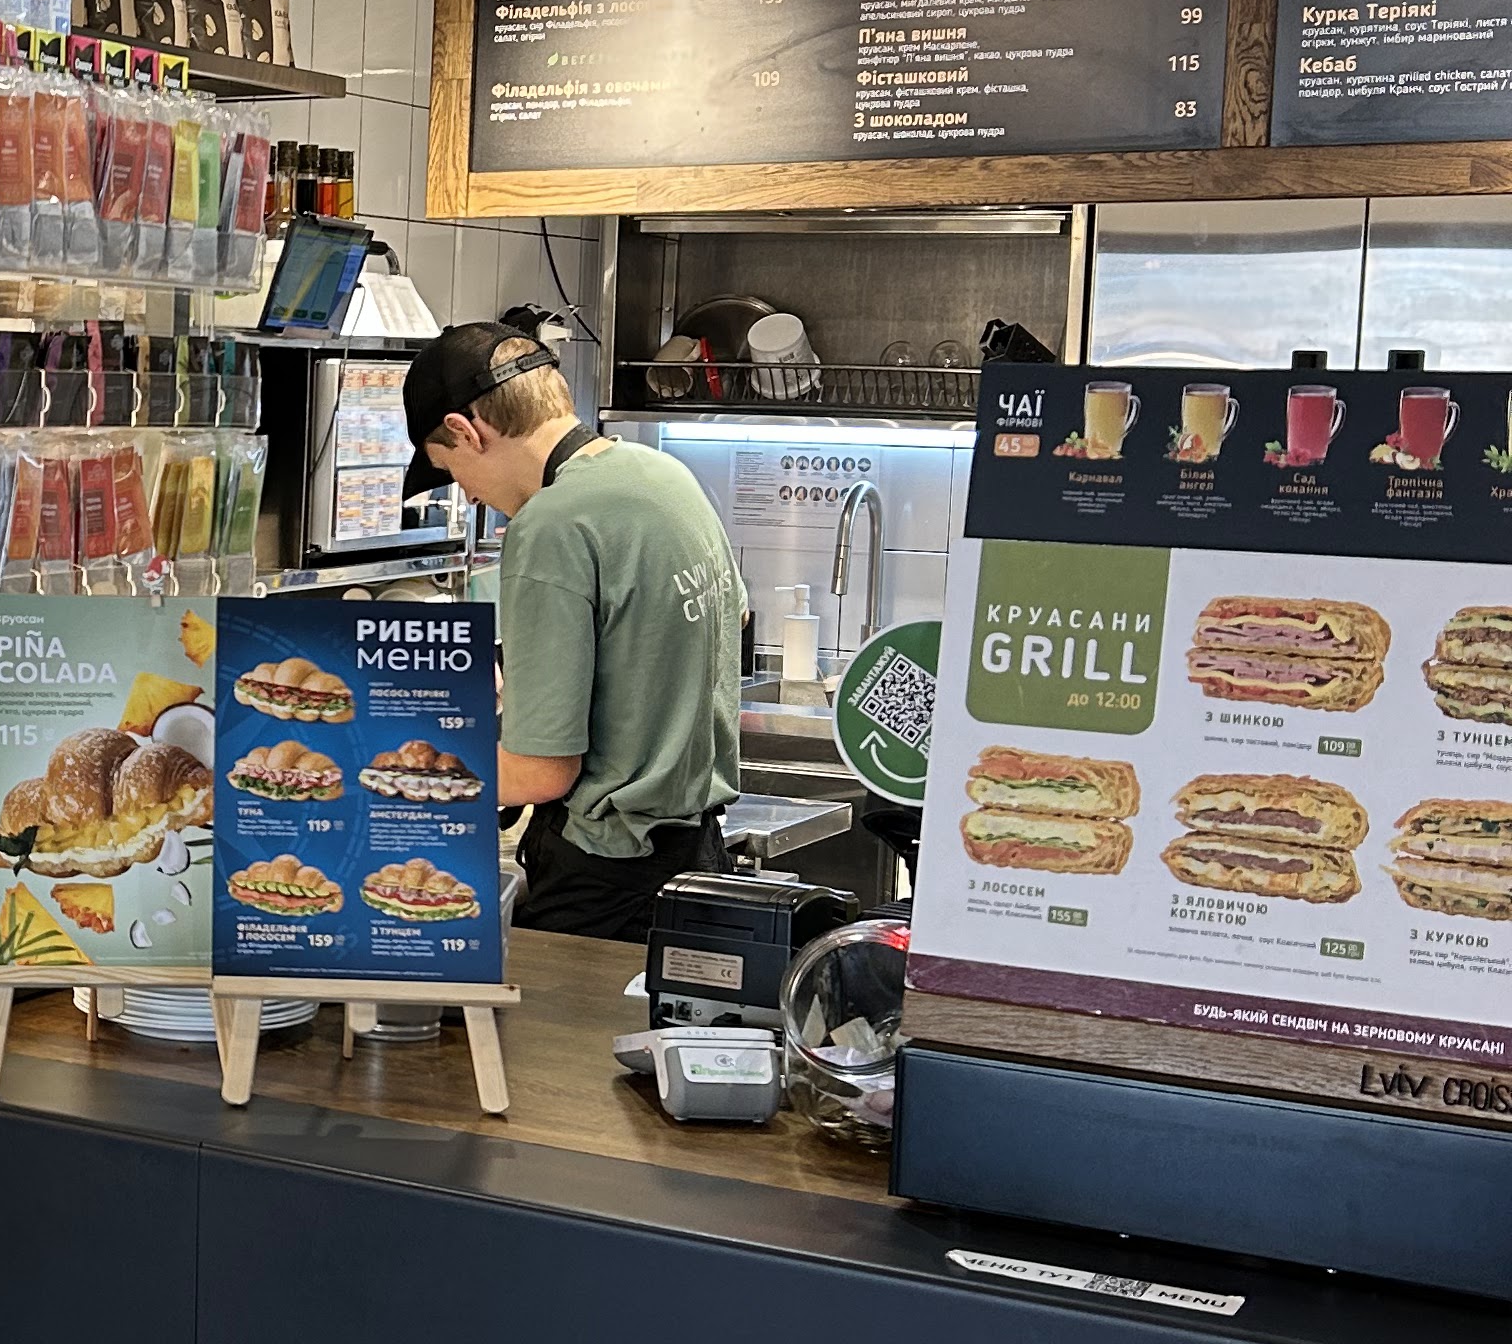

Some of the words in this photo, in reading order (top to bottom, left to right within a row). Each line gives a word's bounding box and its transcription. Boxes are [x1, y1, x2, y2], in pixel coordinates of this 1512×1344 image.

[495, 0, 592, 20] Філадельфія
[597, 2, 605, 13] з
[1181, 7, 1203, 24] 99
[1302, 7, 1359, 26] Курка
[1366, 0, 1437, 22] Теріякі
[859, 28, 905, 44] П'яна
[912, 27, 967, 41] вишня
[1168, 54, 1200, 72] 115
[1299, 56, 1357, 74] Кебаб
[752, 71, 780, 87] 109
[856, 67, 969, 86] Фісташковий
[491, 80, 588, 99] Філадельфія
[592, 82, 600, 94] з
[1348, 85, 1386, 97] цибуля
[1428, 83, 1450, 93] соус
[1455, 80, 1498, 92] Гострий
[1174, 101, 1197, 118] 83
[854, 113, 865, 128] З
[870, 111, 968, 127] шоколадом
[998, 389, 1045, 416] ЧАЇ
[997, 418, 1043, 428] ФІРМОВІ
[998, 437, 1021, 453] 45
[1069, 472, 1123, 484] Карнавал
[1180, 468, 1214, 480] Білий
[1293, 473, 1316, 486] Сад
[1388, 476, 1443, 489] Тропічна
[1179, 481, 1214, 491] ангел
[1279, 484, 1328, 495] кохання
[1386, 488, 1443, 500] фантазія
[1490, 486, 1512, 499] Хра
[986, 604, 1151, 633] КРУАСАНИ
[357, 620, 471, 643] РИБНЕ
[357, 647, 472, 672] меню
[981, 632, 1147, 684] GRILL
[847, 645, 897, 706] ЗАВАНТАЖУЙ
[1067, 694, 1089, 707] до
[1095, 691, 1141, 709] 12:00
[438, 717, 464, 729] 159
[1205, 712, 1213, 722] З
[1220, 712, 1284, 728] ШИНКОЮ
[1437, 730, 1445, 741] З
[1322, 740, 1345, 752] 109
[238, 808, 263, 817] ТУНА
[370, 811, 432, 821] АМСТЕРДАМ
[308, 820, 331, 832] 119
[440, 823, 466, 835] 129
[968, 879, 976, 889] З
[982, 881, 1046, 898] ЛОСОСЕМ
[1171, 894, 1180, 906] З
[1186, 895, 1268, 915] ЯЛОВИЧОЮ
[1050, 909, 1071, 922] 155
[1170, 908, 1247, 926] КОТЛЕТОЮ
[308, 934, 334, 947] 159
[380, 928, 421, 937] ТУНЦЕМ
[1410, 929, 1418, 940] З
[1425, 930, 1489, 948] КУРКОЮ
[441, 938, 466, 951] 119
[1324, 942, 1346, 955] 125
[1194, 1004, 1269, 1023] БУДЬ-ЯКИЙ
[1272, 1014, 1328, 1032] СЕНДВІЧ
[1331, 1022, 1349, 1035] НА
[1353, 1024, 1435, 1045] ЗЕРНОВОМУ
[1438, 1035, 1505, 1055] КРУАСАНІ
[1360, 1063, 1433, 1098] Lviv
[1038, 1269, 1074, 1281] ТУТ
[1159, 1290, 1226, 1307] MENU
